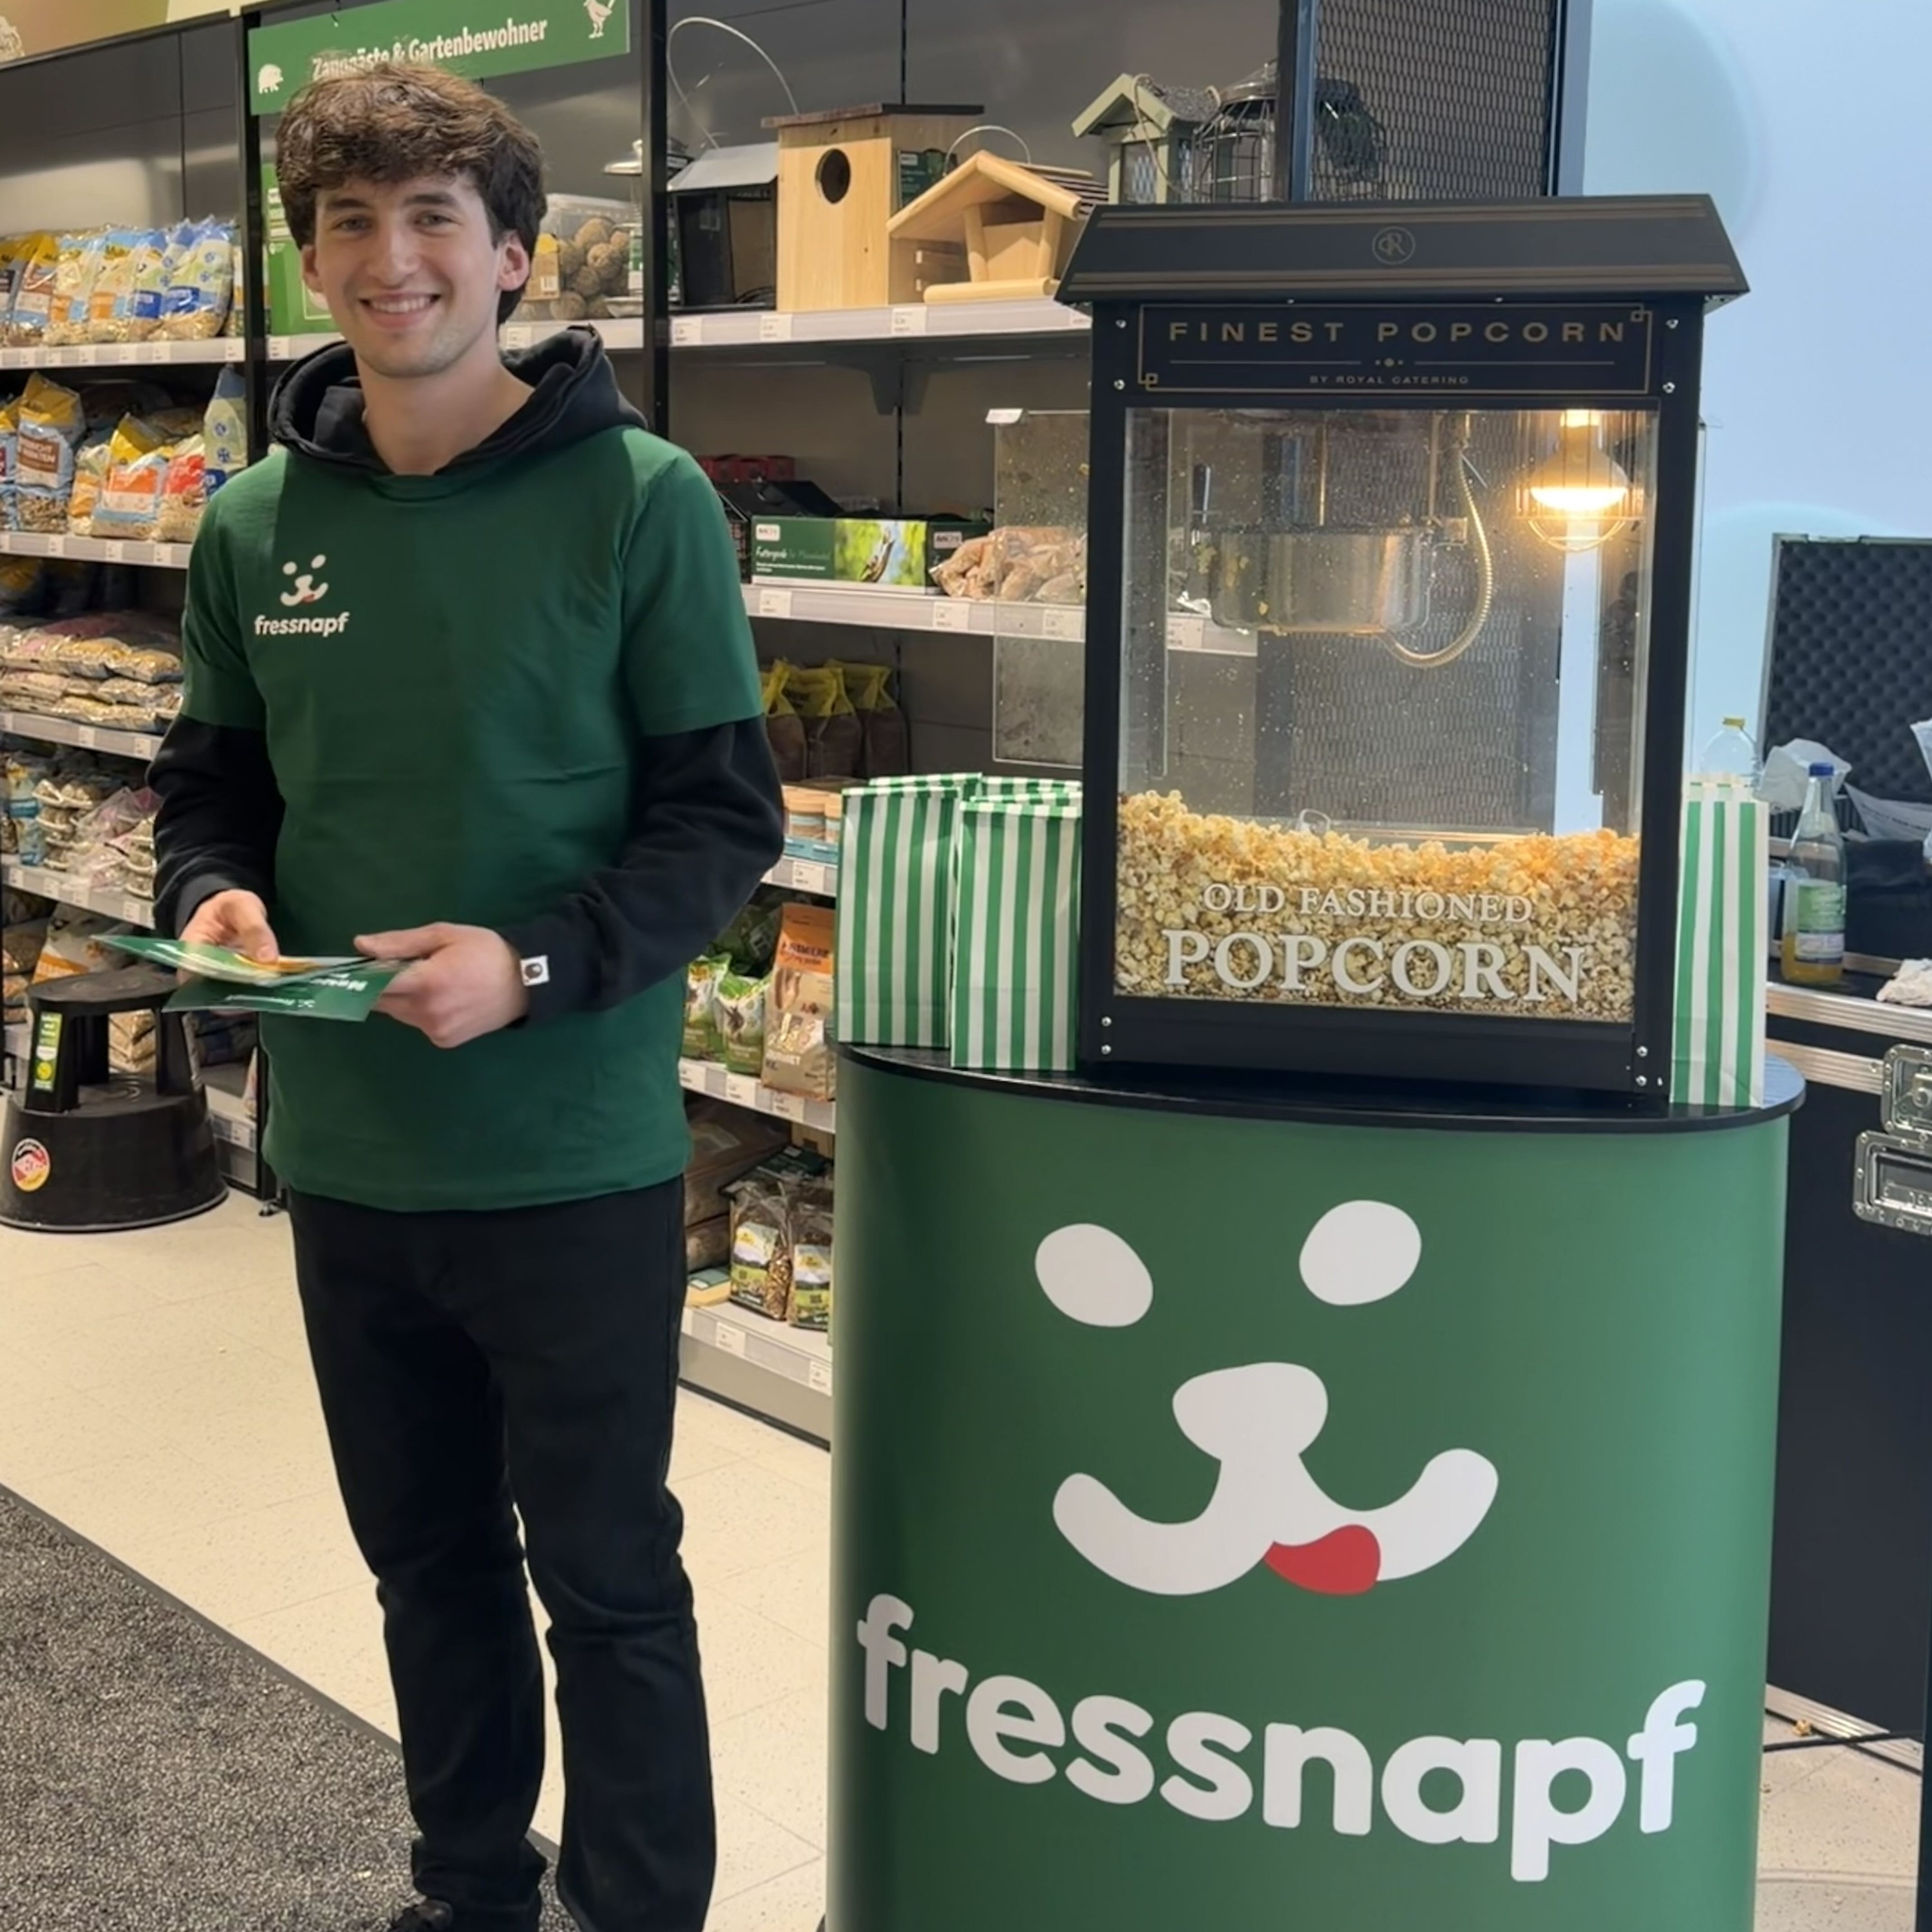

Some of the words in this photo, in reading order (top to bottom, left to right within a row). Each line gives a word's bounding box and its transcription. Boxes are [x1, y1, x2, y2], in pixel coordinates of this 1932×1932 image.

[408, 17, 547, 62] Gartenbewohner
[1169, 322, 1344, 342] FINEST
[1377, 322, 1624, 343] POPCORN
[1309, 375, 1329, 384] BY
[1335, 375, 1385, 385] ROYAL
[1391, 375, 1469, 385] CATERING
[254, 611, 350, 638] fressnapf
[1203, 883, 1285, 913] OLD
[1300, 887, 1533, 923] FASHIONED
[1161, 929, 1586, 1004] POPCORN
[857, 1593, 1707, 1882] fressnapf
